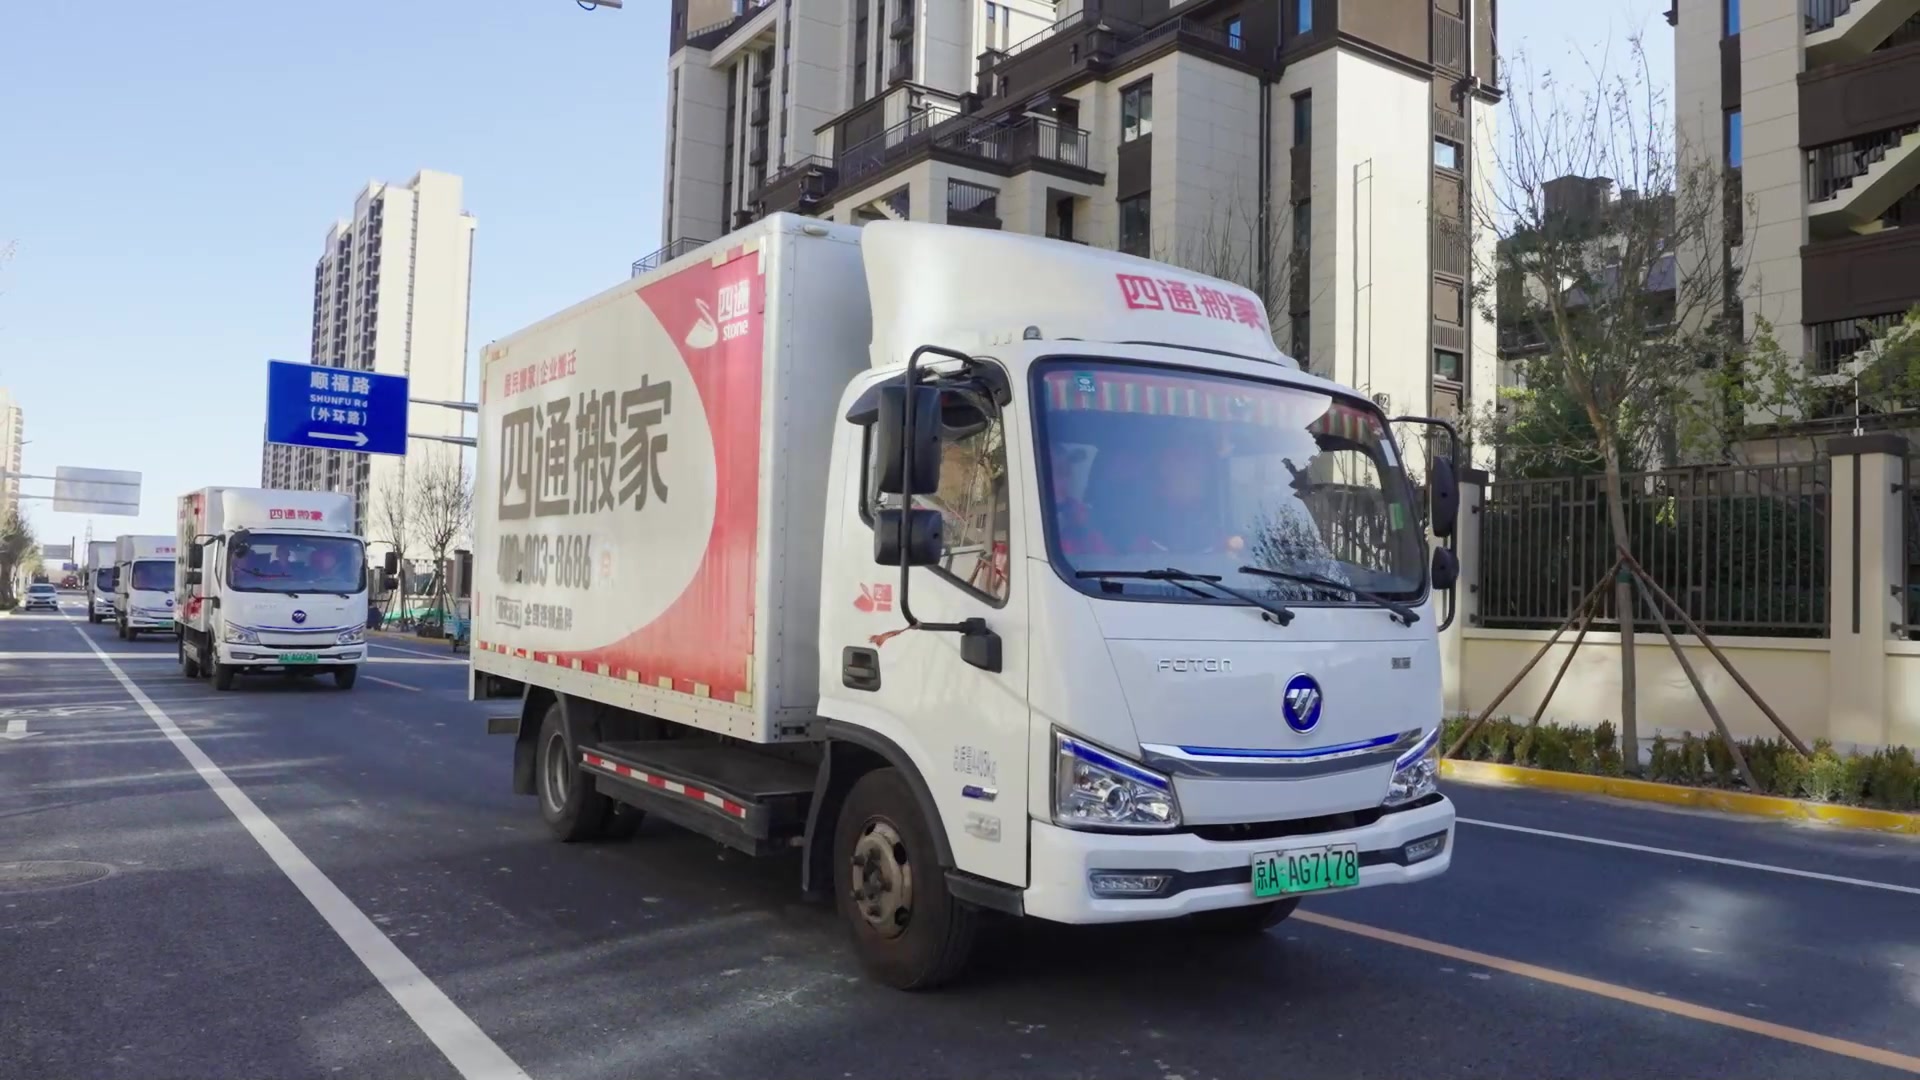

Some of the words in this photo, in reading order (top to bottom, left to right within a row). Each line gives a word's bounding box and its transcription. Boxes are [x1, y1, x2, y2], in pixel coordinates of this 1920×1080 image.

[1116, 273, 1265, 330] 四通搬家
[309, 394, 352, 407] SHUNFU
[310, 371, 370, 395] 顺福路
[499, 373, 672, 521] 四通搬家
